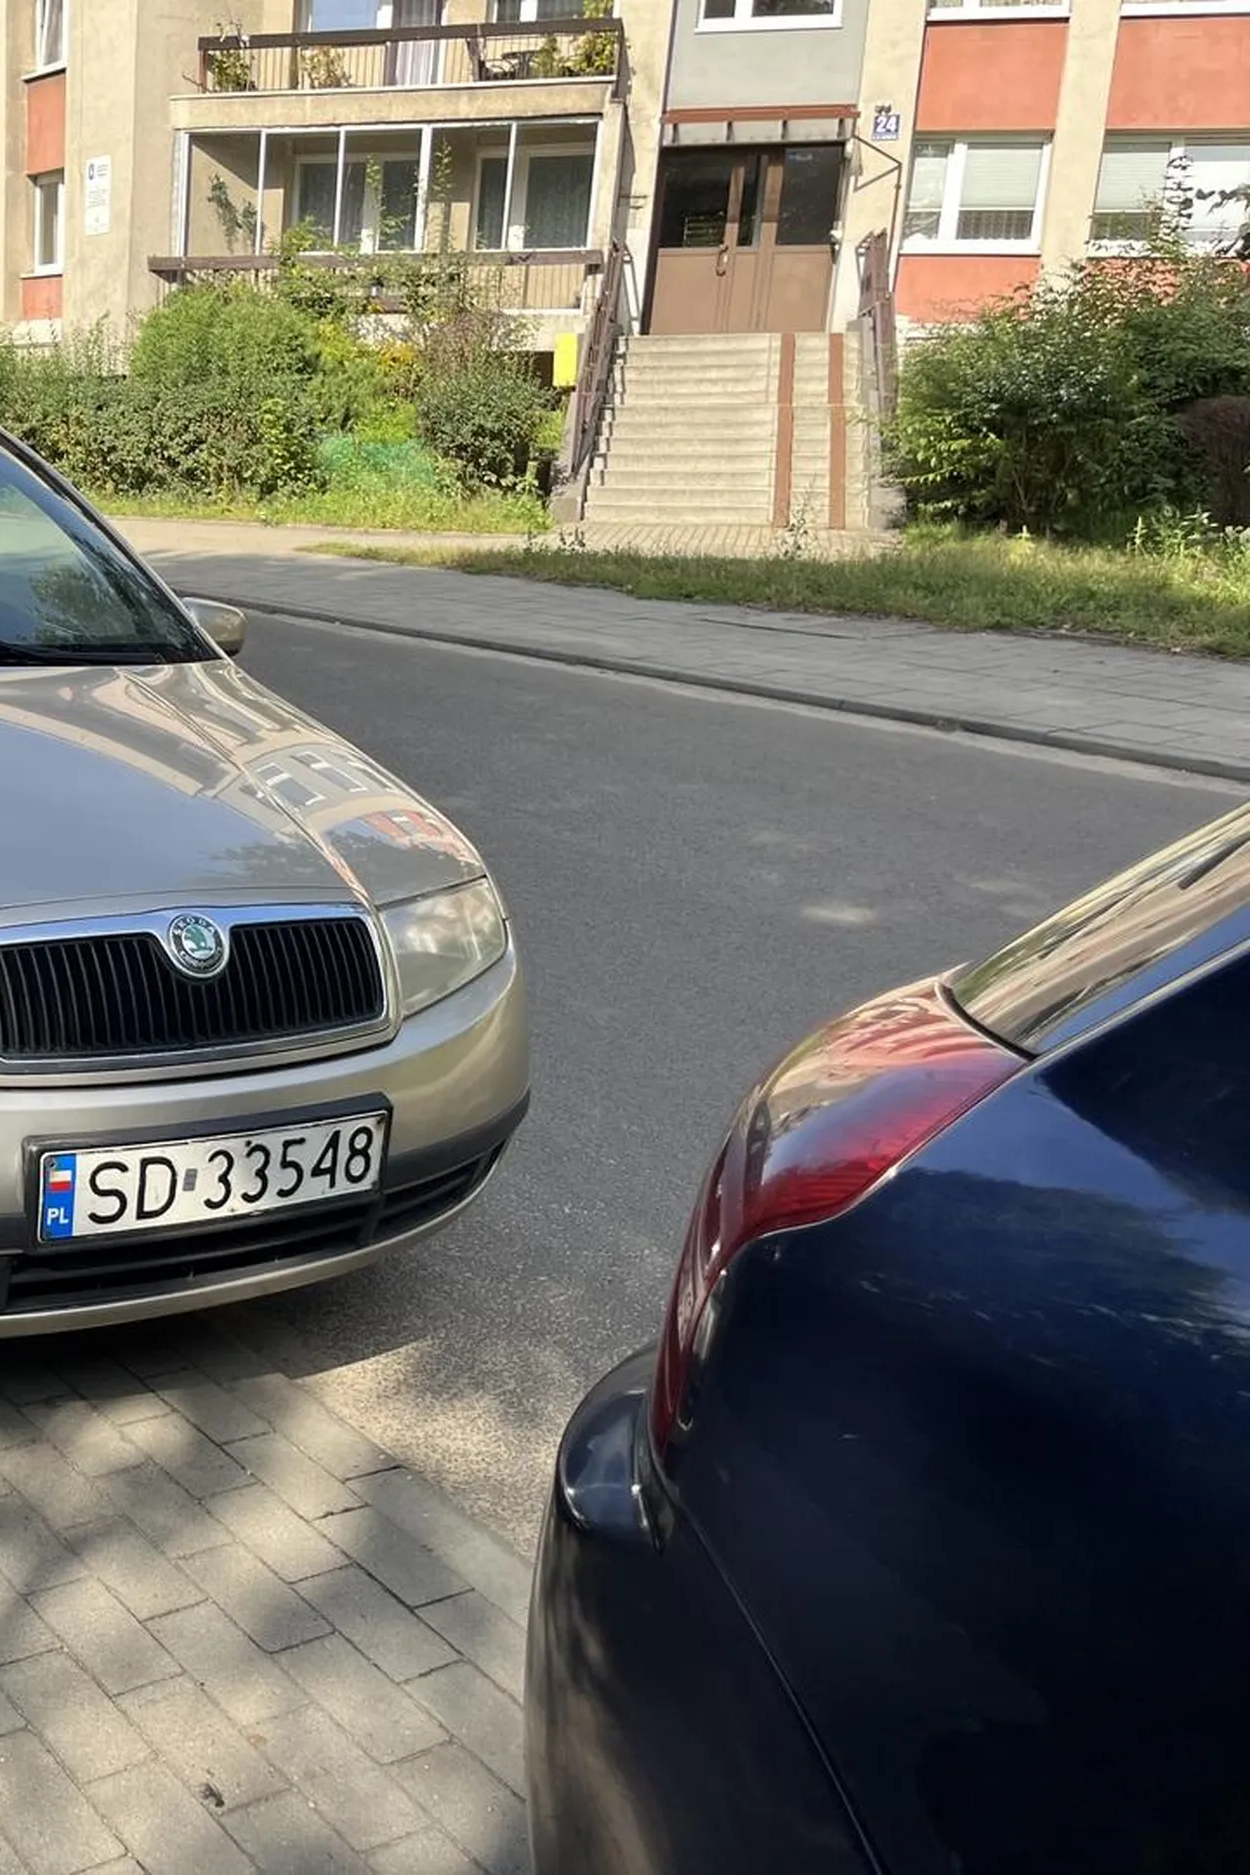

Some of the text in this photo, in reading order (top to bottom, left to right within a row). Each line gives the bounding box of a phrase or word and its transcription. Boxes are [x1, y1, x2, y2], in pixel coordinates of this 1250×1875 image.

[876, 115, 896, 133] 24
[88, 1126, 374, 1225] SD 33548
[47, 1207, 70, 1226] PL
